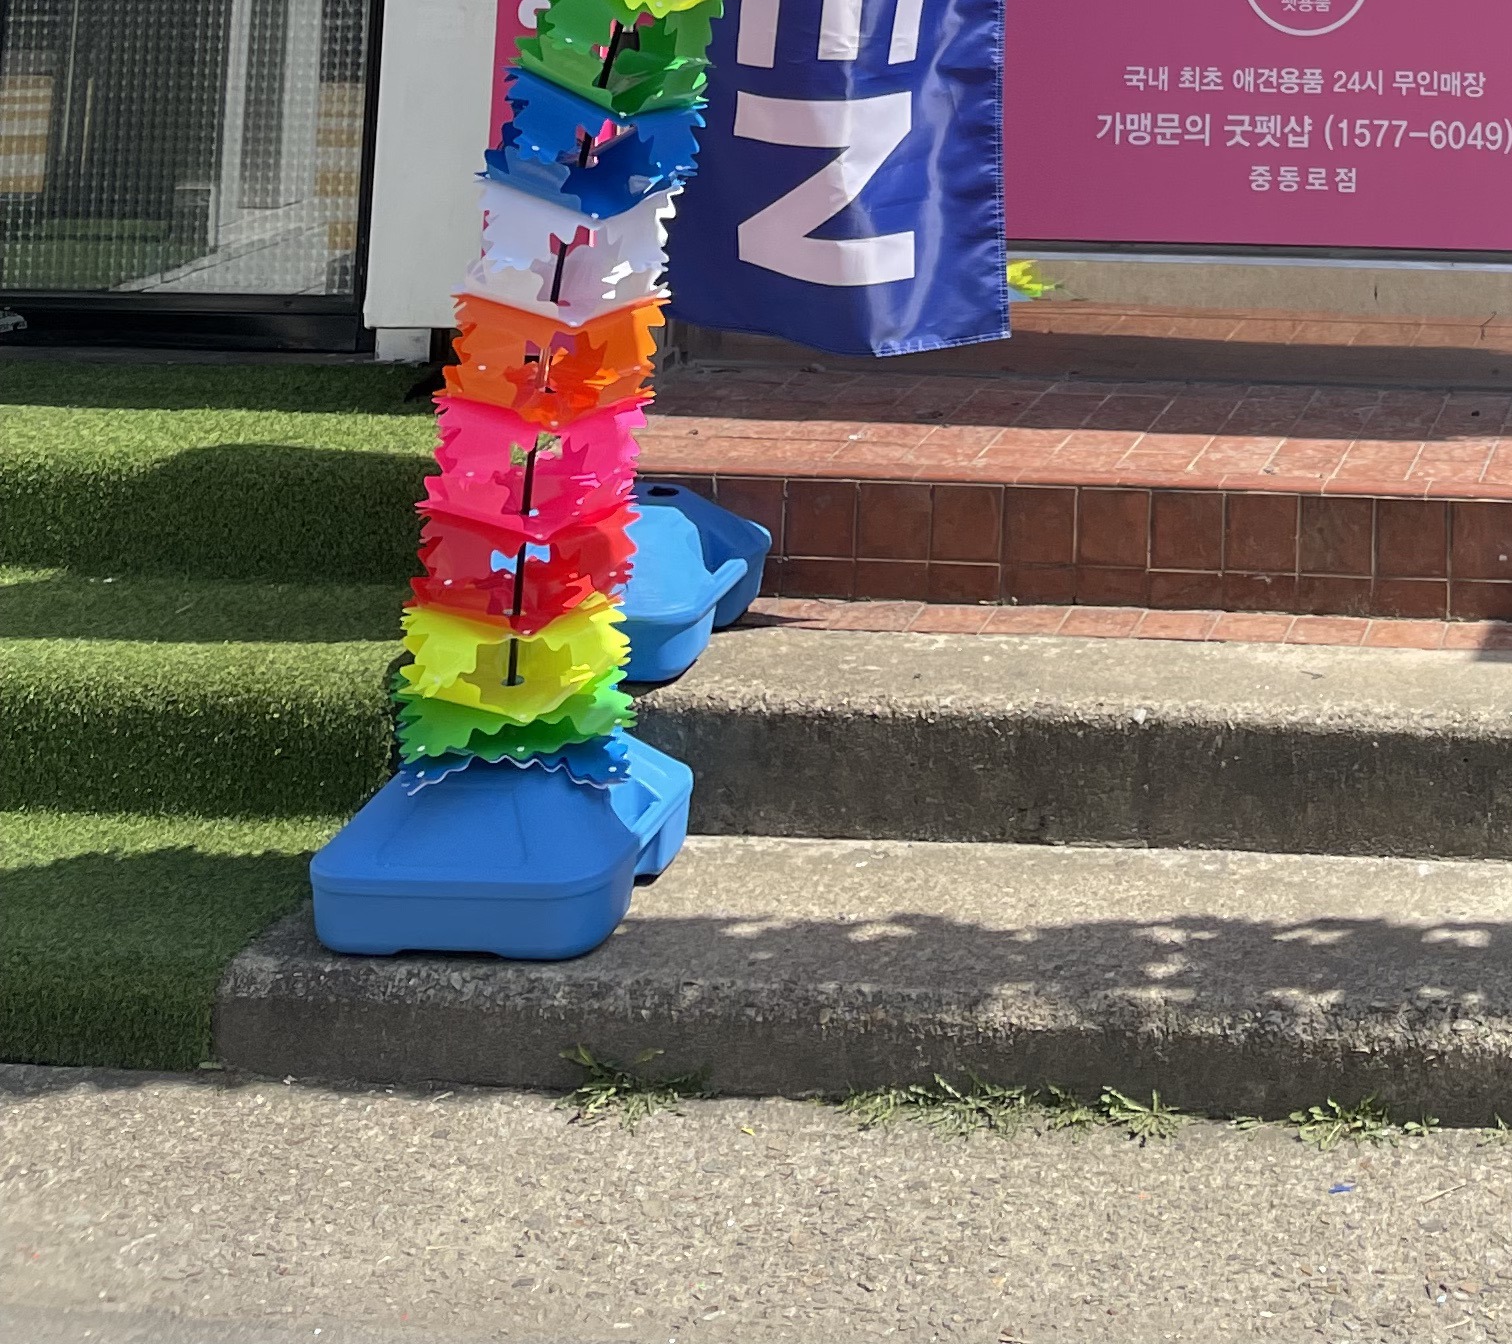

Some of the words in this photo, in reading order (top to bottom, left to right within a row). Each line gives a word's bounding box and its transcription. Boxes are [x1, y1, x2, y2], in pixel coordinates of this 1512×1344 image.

[1123, 65, 1169, 92] 국내
[1178, 65, 1224, 93] 최초
[1232, 67, 1325, 95] 애견용품
[1333, 69, 1384, 96] 24시
[1392, 70, 1486, 98] 무인매장
[1095, 112, 1211, 147] 가맹문의
[1223, 114, 1313, 150] 굿펫샵
[1248, 165, 1358, 194] 중동로점
